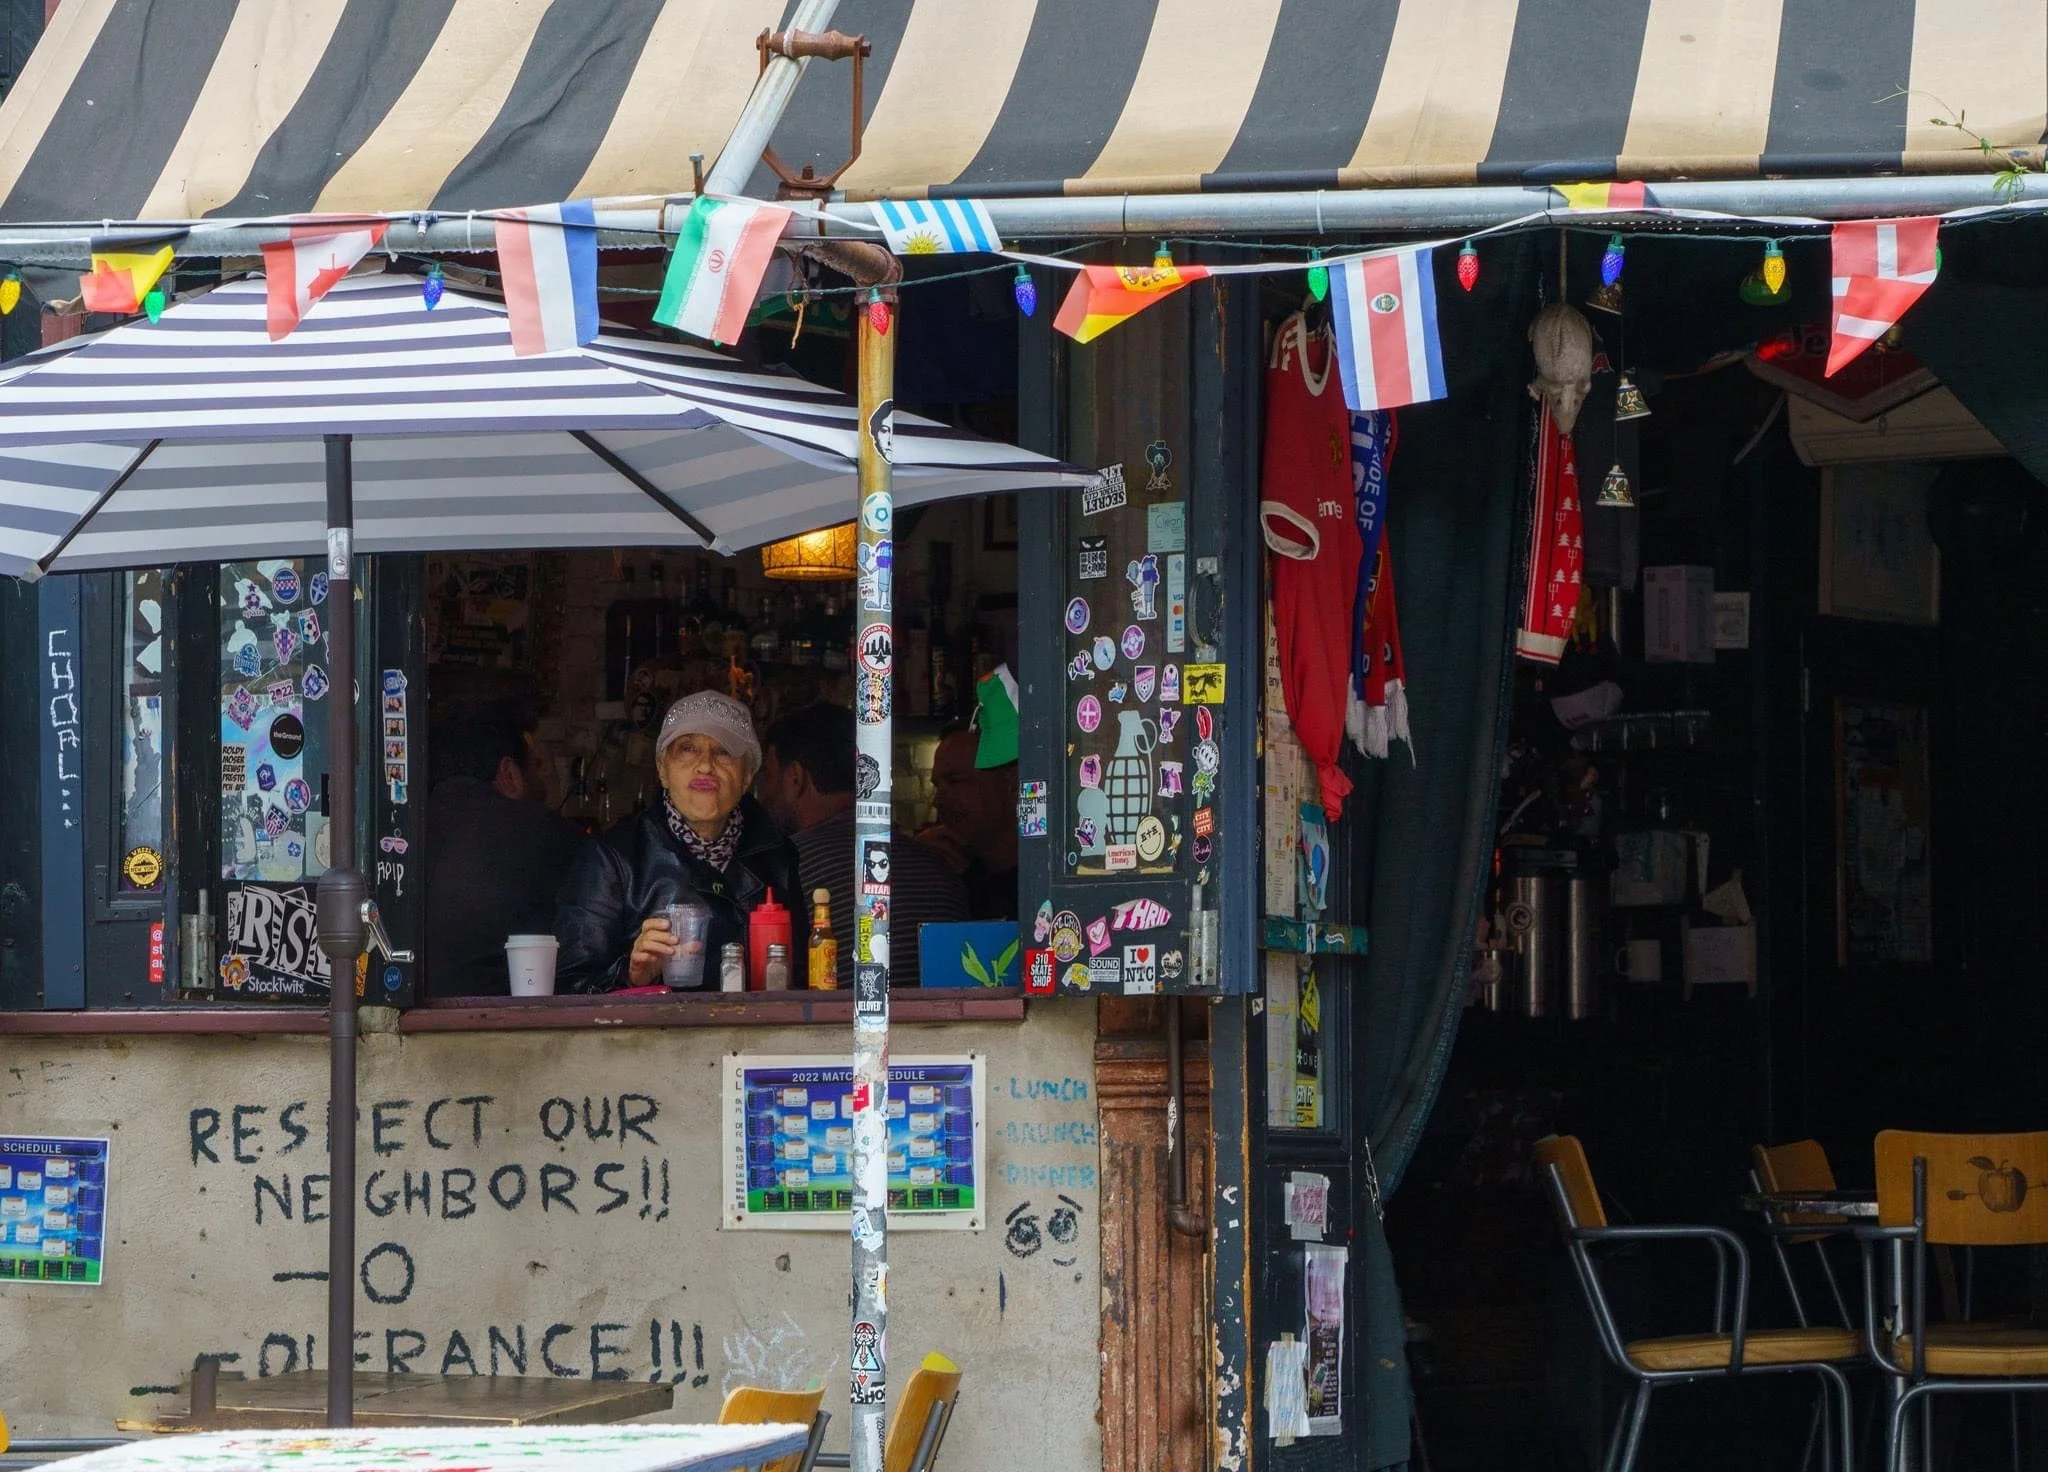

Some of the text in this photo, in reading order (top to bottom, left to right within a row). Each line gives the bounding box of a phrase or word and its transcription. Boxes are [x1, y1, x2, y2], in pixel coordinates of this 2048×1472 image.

[222, 755, 245, 764] MOSER
[222, 773, 246, 783] PRESTO
[1194, 811, 1210, 820] CITY
[1196, 824, 1211, 834] CITY
[1035, 953, 1049, 965] 510
[1091, 959, 1119, 969] SOUND
[1030, 964, 1053, 976] SKATE
[247, 975, 304, 994] StockTwits
[1032, 975, 1052, 987] SHOP
[791, 1072, 819, 1083] 2022
[821, 1071, 856, 1082] MATC
[1009, 1077, 1088, 1102] LUNCH
[189, 1094, 496, 1168] RESECT
[540, 1093, 661, 1146] OUR
[3, 1142, 62, 1154] SCHEDULE
[252, 1155, 671, 1225] NEGHBORS!!
